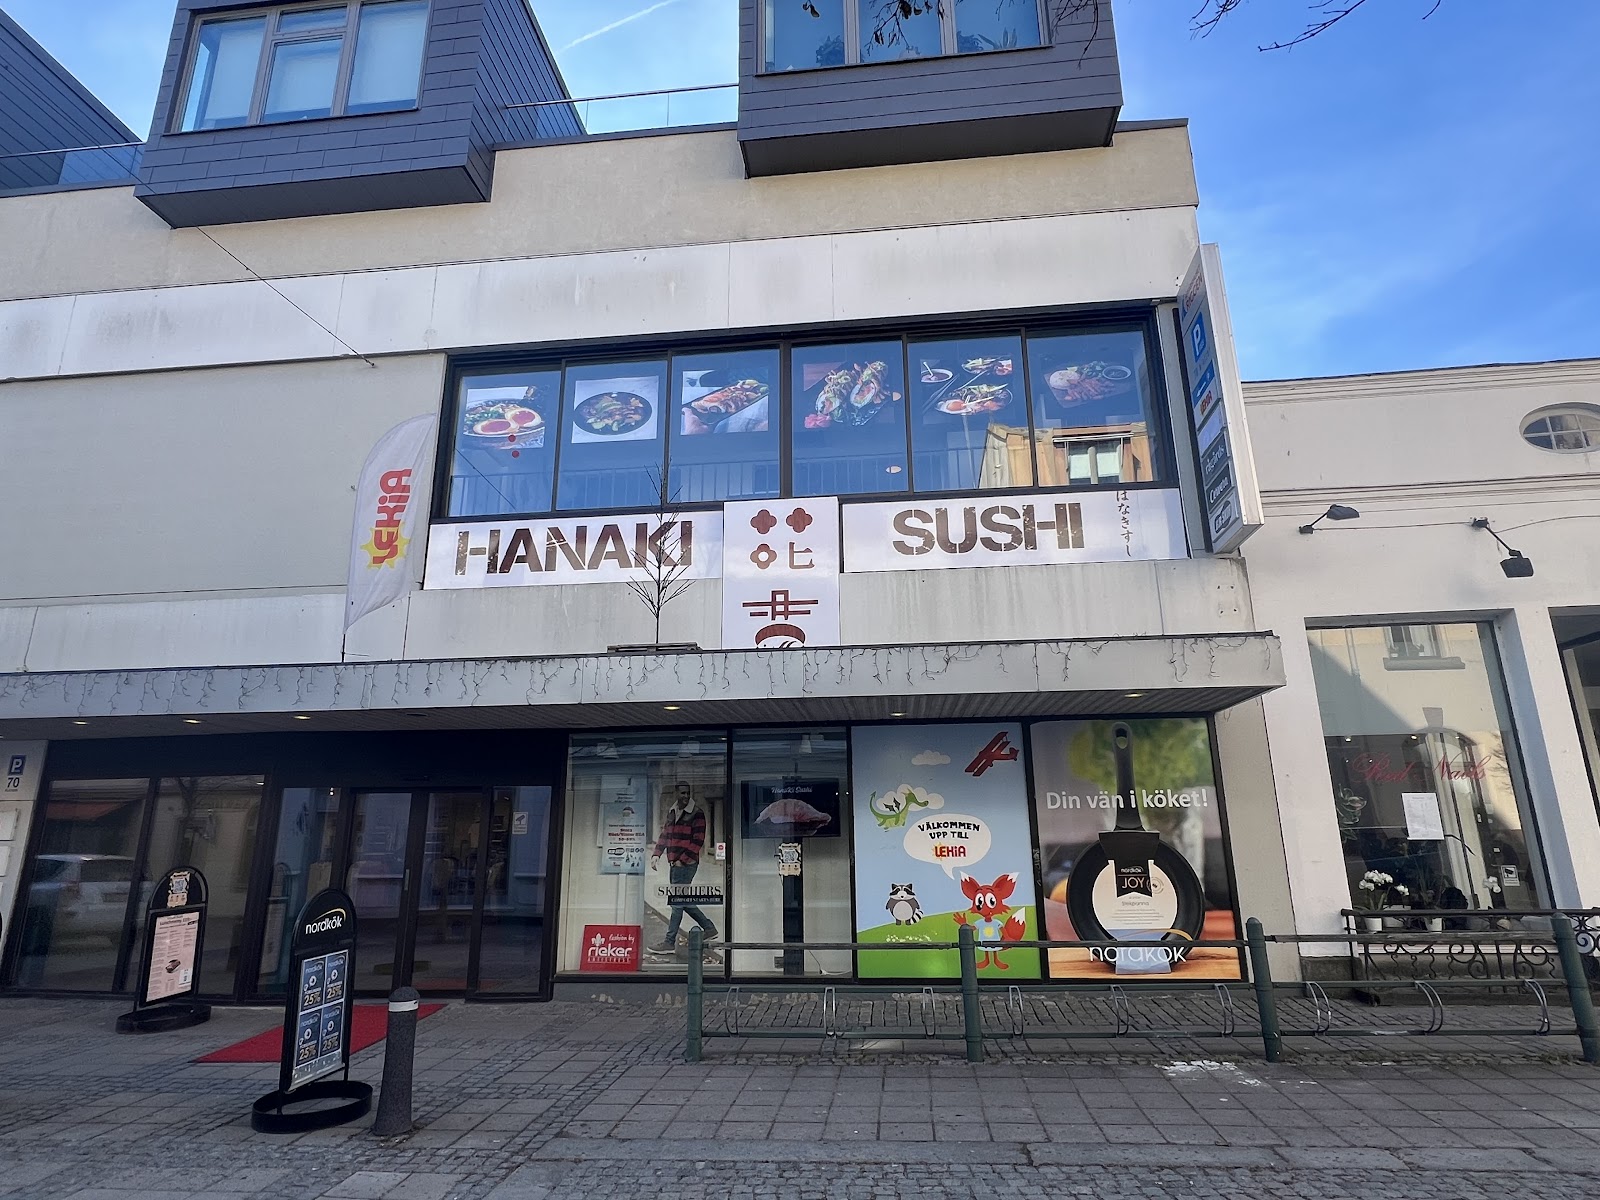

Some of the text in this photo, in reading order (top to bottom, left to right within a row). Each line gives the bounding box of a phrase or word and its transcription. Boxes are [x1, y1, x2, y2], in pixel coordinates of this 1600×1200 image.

[454, 502, 1085, 576] HANAKI SUSHI
[7, 777, 20, 788] 70
[1046, 788, 1208, 809] Din vän i köket!
[918, 821, 980, 832] VÄLKOMMEN
[929, 831, 969, 839] UPP TILL
[1122, 877, 1145, 889] JOY
[657, 885, 722, 896] SKECHERS
[305, 915, 343, 934] nordkök
[588, 943, 632, 957] rieker
[304, 993, 321, 1006] 25%
[327, 987, 342, 999] 25%
[322, 1037, 339, 1051] 25%
[299, 1045, 317, 1060] 25%
